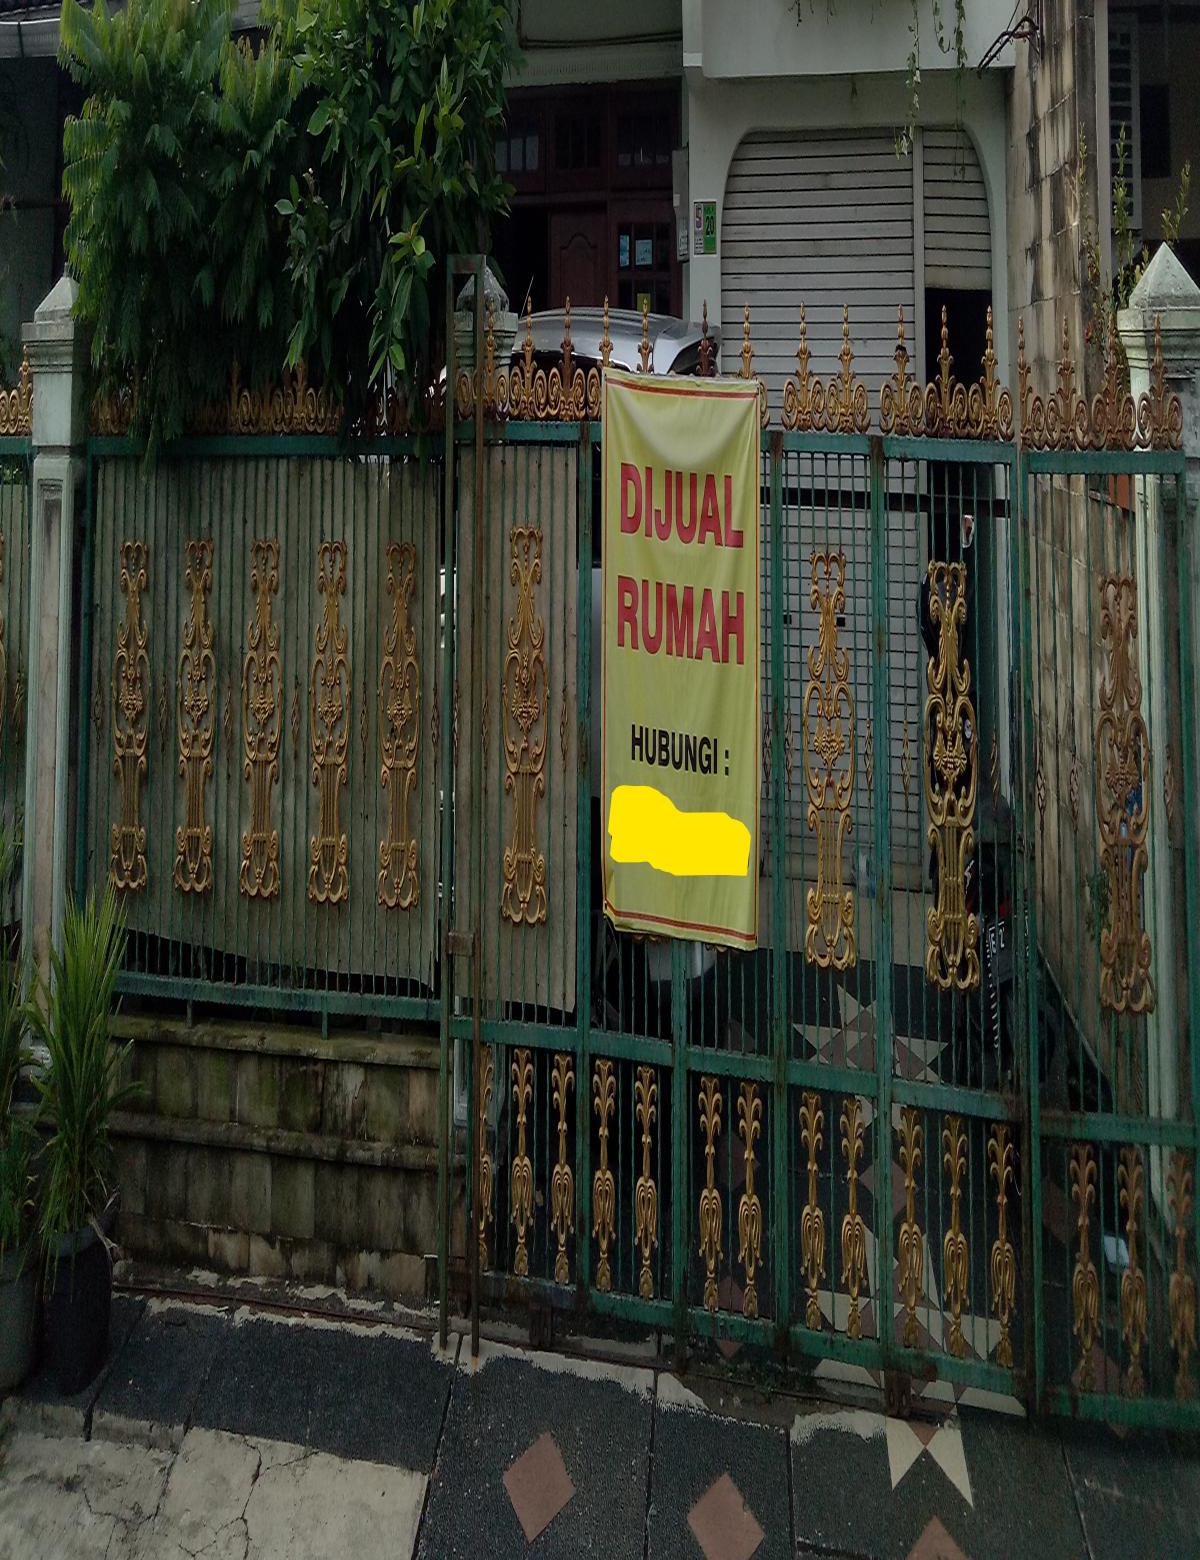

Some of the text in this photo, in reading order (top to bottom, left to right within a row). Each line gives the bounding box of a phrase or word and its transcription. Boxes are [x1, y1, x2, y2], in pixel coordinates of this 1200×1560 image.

[706, 215, 715, 235] 20
[620, 462, 744, 548] DIJUAL
[617, 575, 745, 665] RUMAH
[631, 724, 718, 774] HUBUNGI
